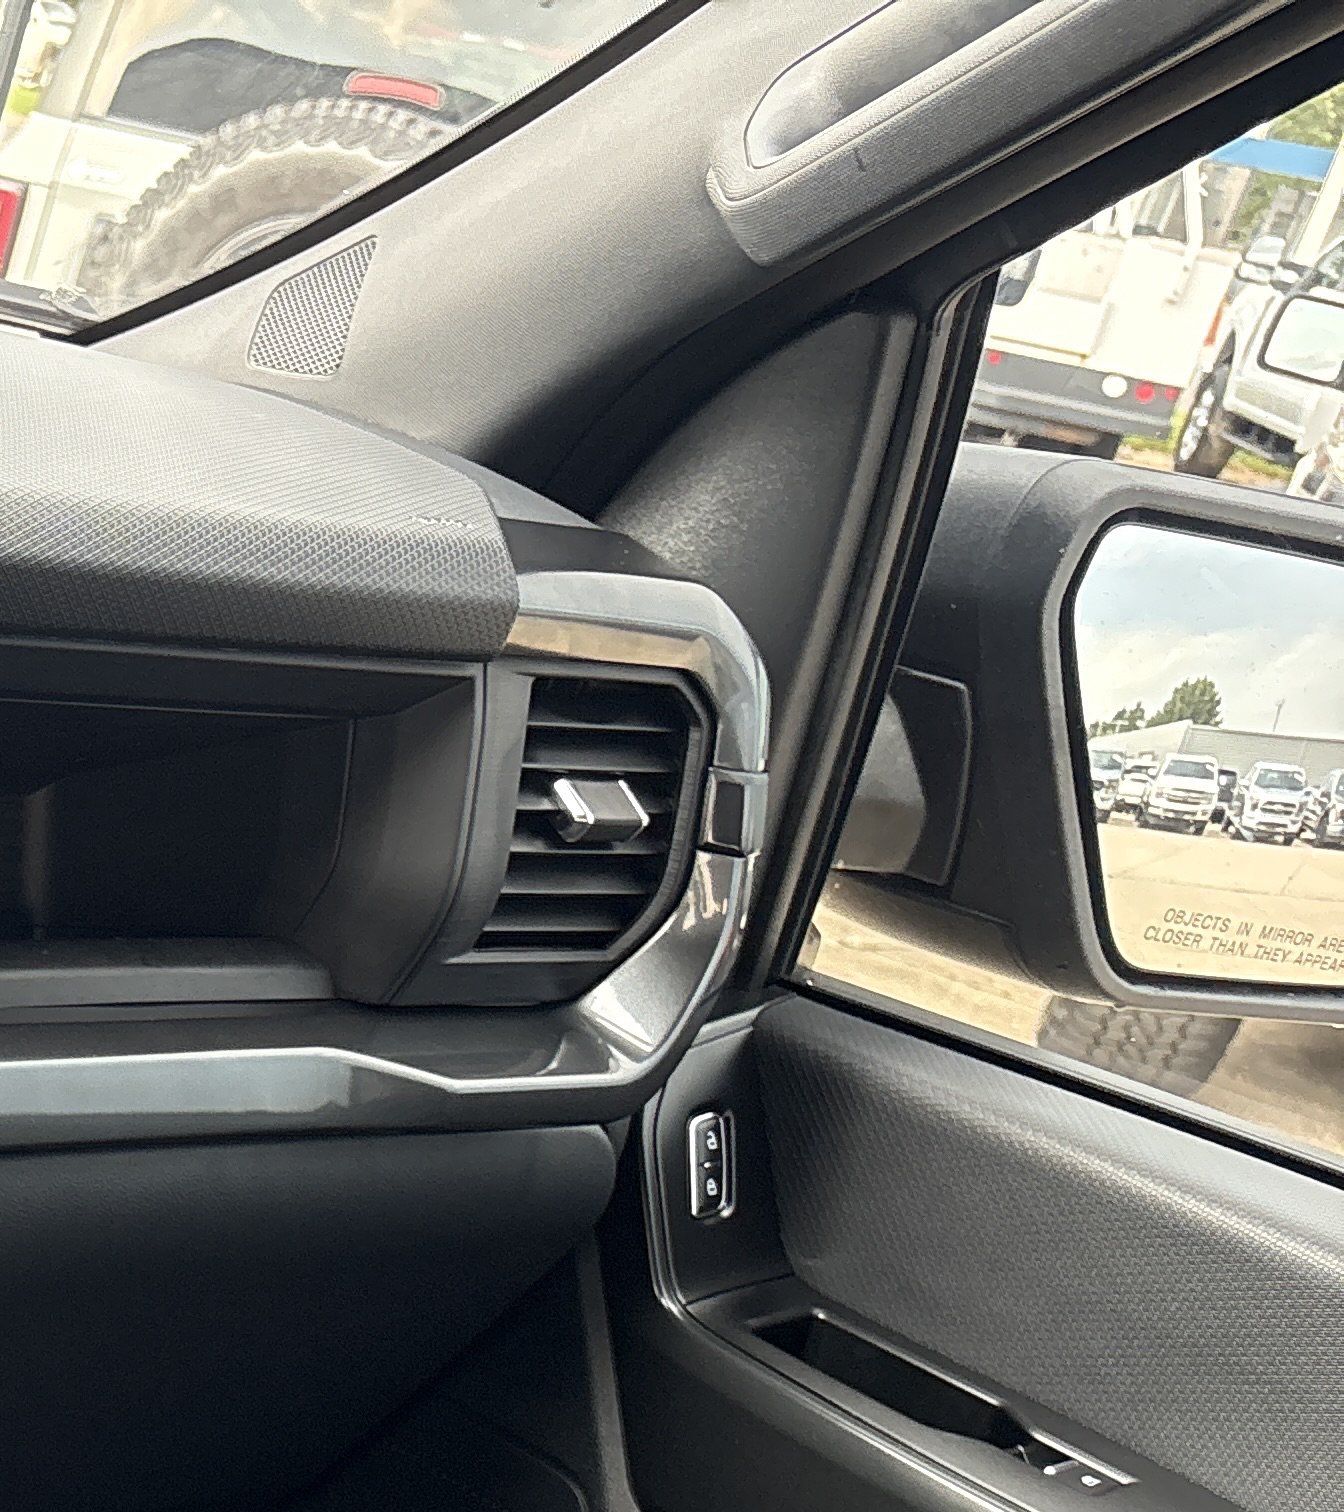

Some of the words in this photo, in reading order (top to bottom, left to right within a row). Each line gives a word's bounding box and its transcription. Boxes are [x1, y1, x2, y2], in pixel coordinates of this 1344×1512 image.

[1143, 925, 1204, 950] CLOSER
[1209, 936, 1250, 957] THAN
[1253, 944, 1293, 964] THEY
[1163, 907, 1232, 933] OBJECTS
[1236, 921, 1254, 937] IN
[1258, 925, 1315, 948] MIRROR
